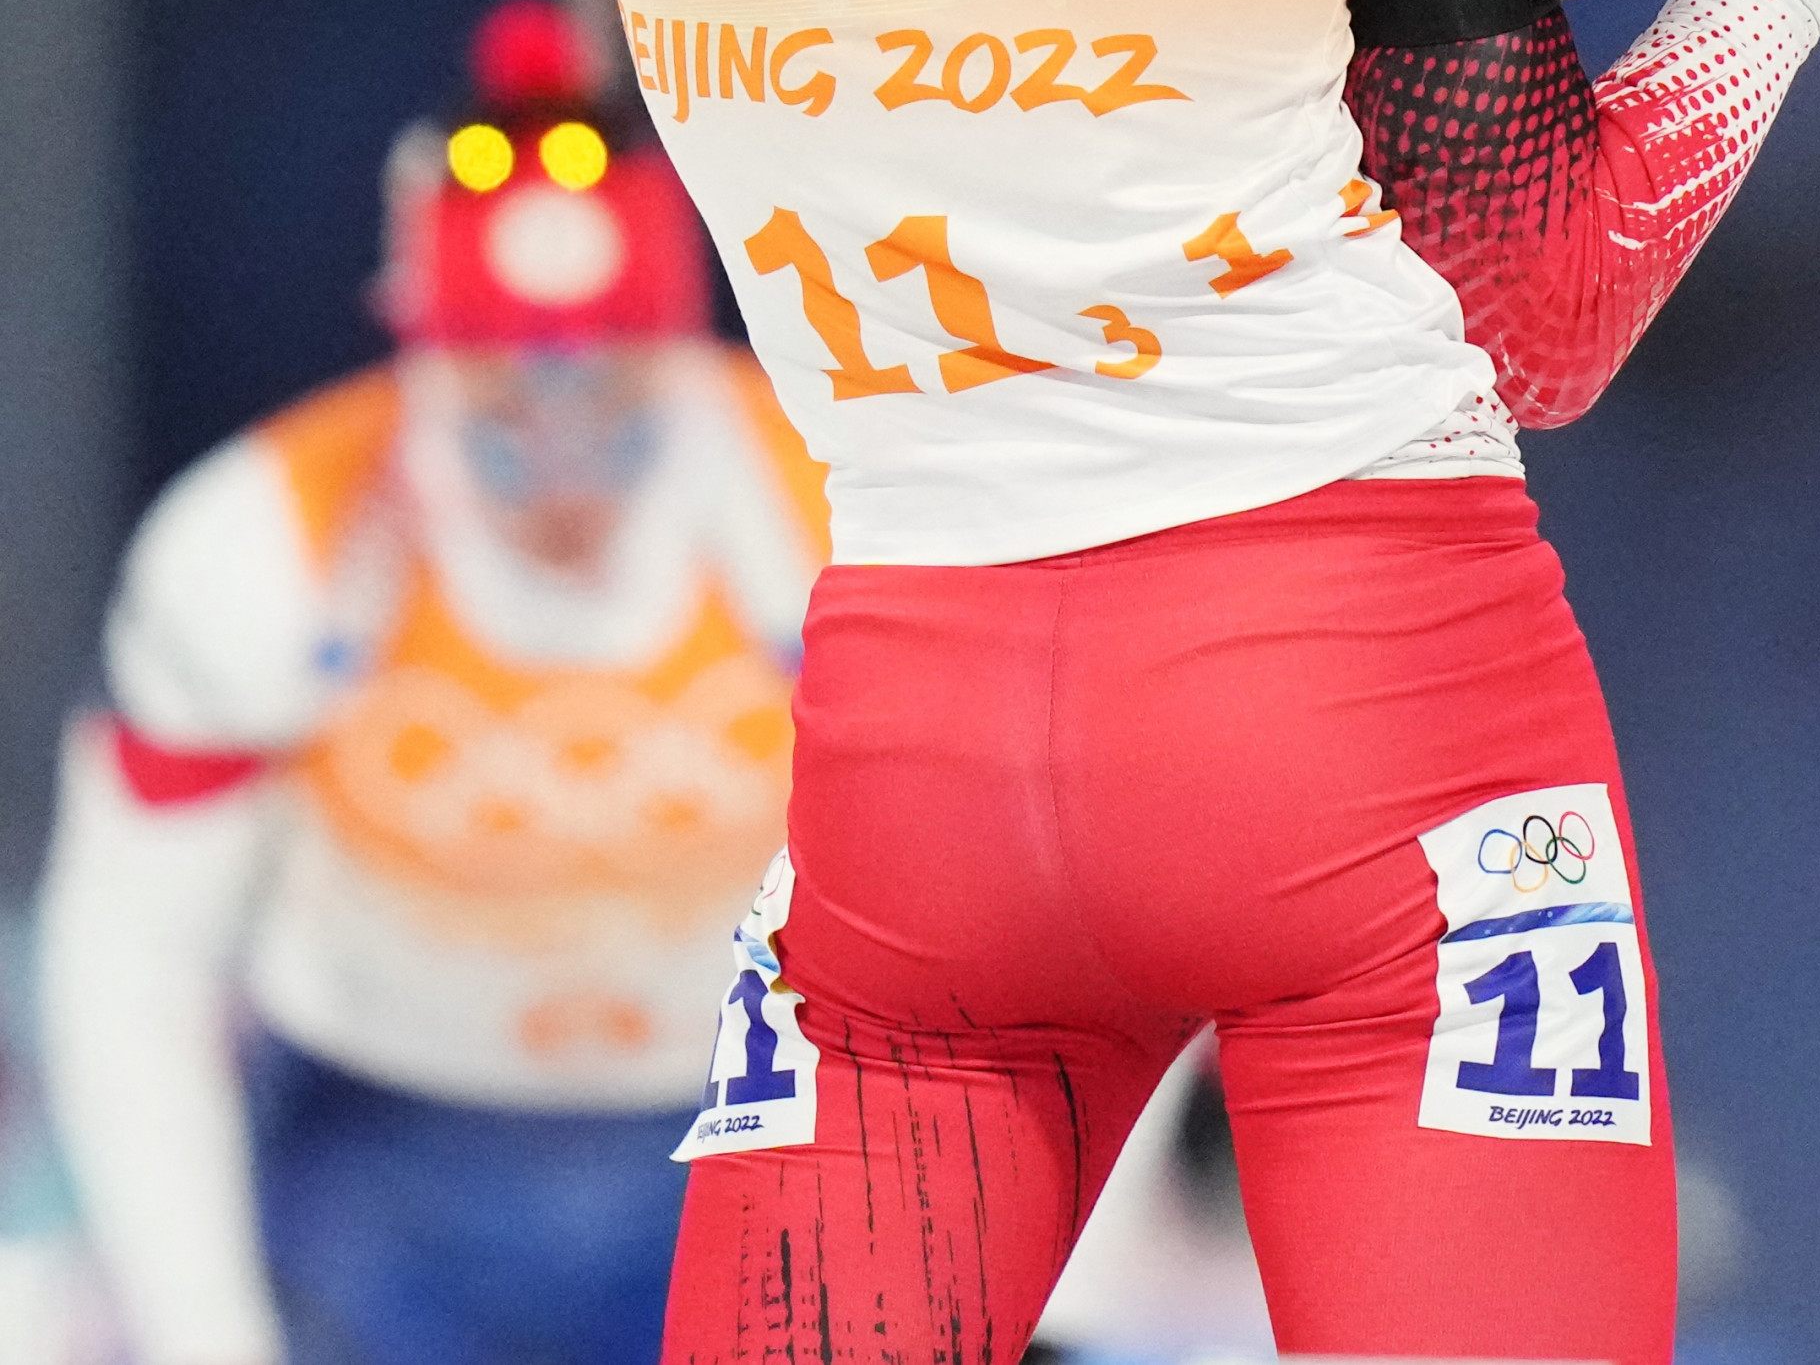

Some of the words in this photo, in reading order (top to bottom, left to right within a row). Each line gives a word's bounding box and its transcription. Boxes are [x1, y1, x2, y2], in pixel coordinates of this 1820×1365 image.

[874, 27, 1193, 117] 2022
[742, 204, 1060, 402] 11
[1076, 304, 1163, 379] 3
[701, 969, 796, 1107] 1
[1455, 941, 1641, 1101] 11
[724, 1114, 765, 1133] 2022
[1488, 1106, 1564, 1130] BEIJING
[1567, 1109, 1618, 1128] 2022
